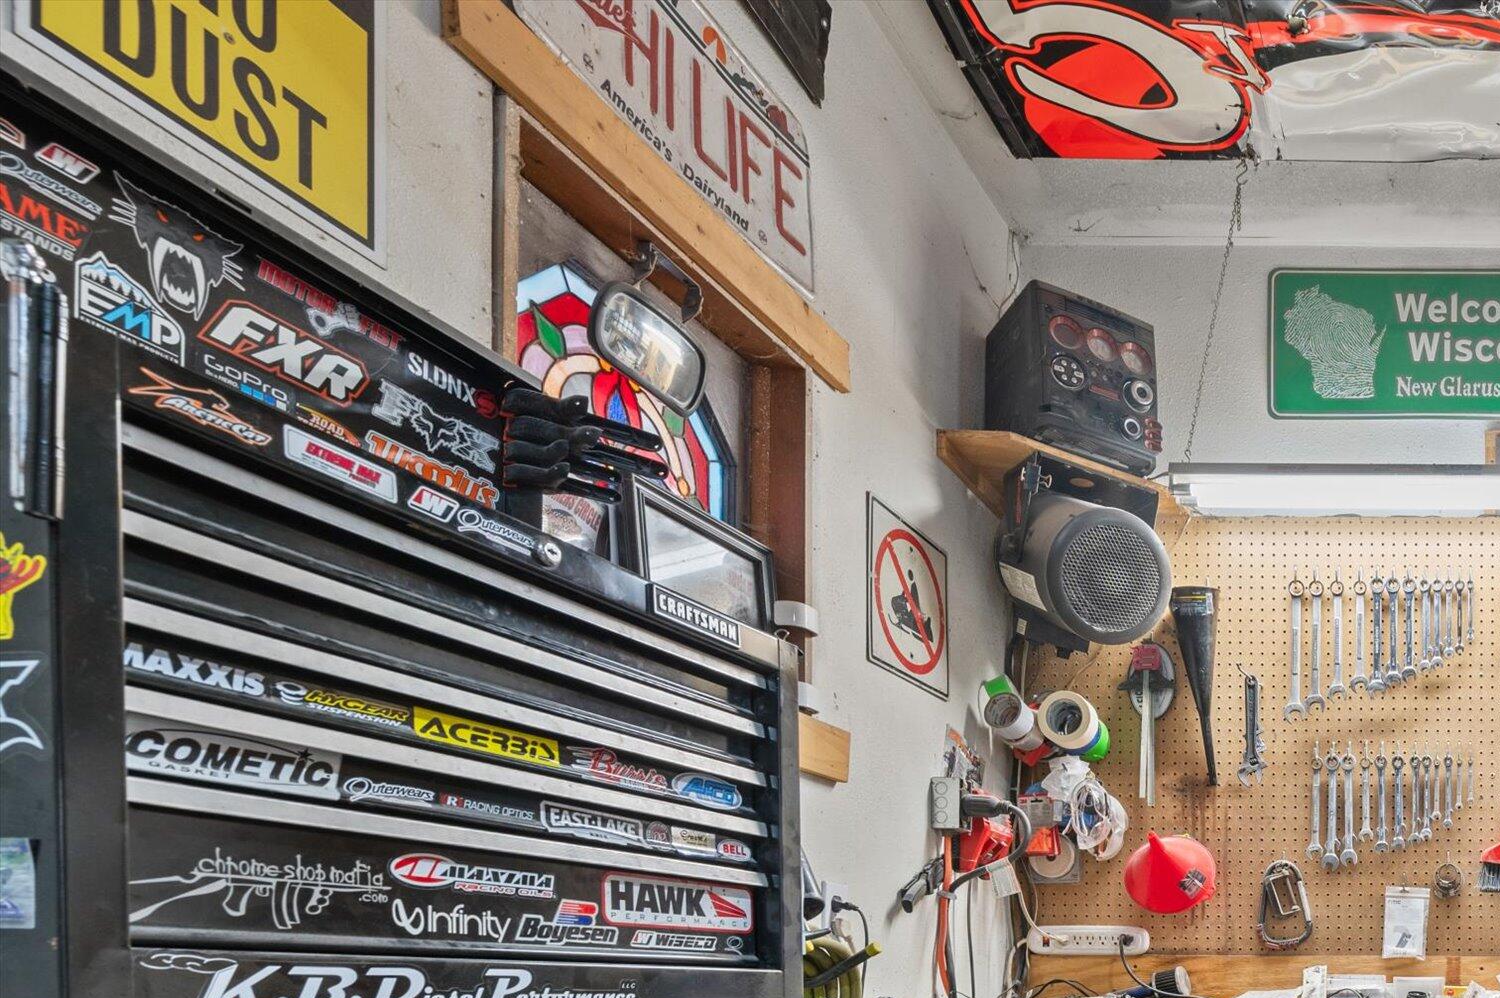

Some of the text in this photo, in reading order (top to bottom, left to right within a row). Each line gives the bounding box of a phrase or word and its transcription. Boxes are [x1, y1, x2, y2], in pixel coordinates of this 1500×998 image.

[600, 78, 750, 232] America's Dairyland
[692, 58, 807, 256] LIFE
[79, 284, 183, 348] EMP
[210, 305, 368, 400] FXR
[203, 352, 288, 402] GoPro
[1396, 376, 1436, 398] New
[310, 413, 345, 437] ROAD
[659, 594, 738, 641] CRAFTSMAN
[305, 702, 402, 727] SUSPENSION
[126, 729, 334, 787] COMETIC
[149, 760, 231, 779] GASKET
[344, 776, 435, 804] Outerwears
[464, 800, 534, 821] RACING OPTICS
[722, 843, 747, 857] BELL
[198, 847, 384, 893] chrome shop mafia
[358, 892, 389, 905] .com
[454, 881, 555, 898] RACING OILS
[610, 880, 706, 917] HAWK
[426, 903, 512, 943] Infinity
[518, 916, 618, 944] Boyesen
[611, 911, 750, 928] PERFORMANCE
